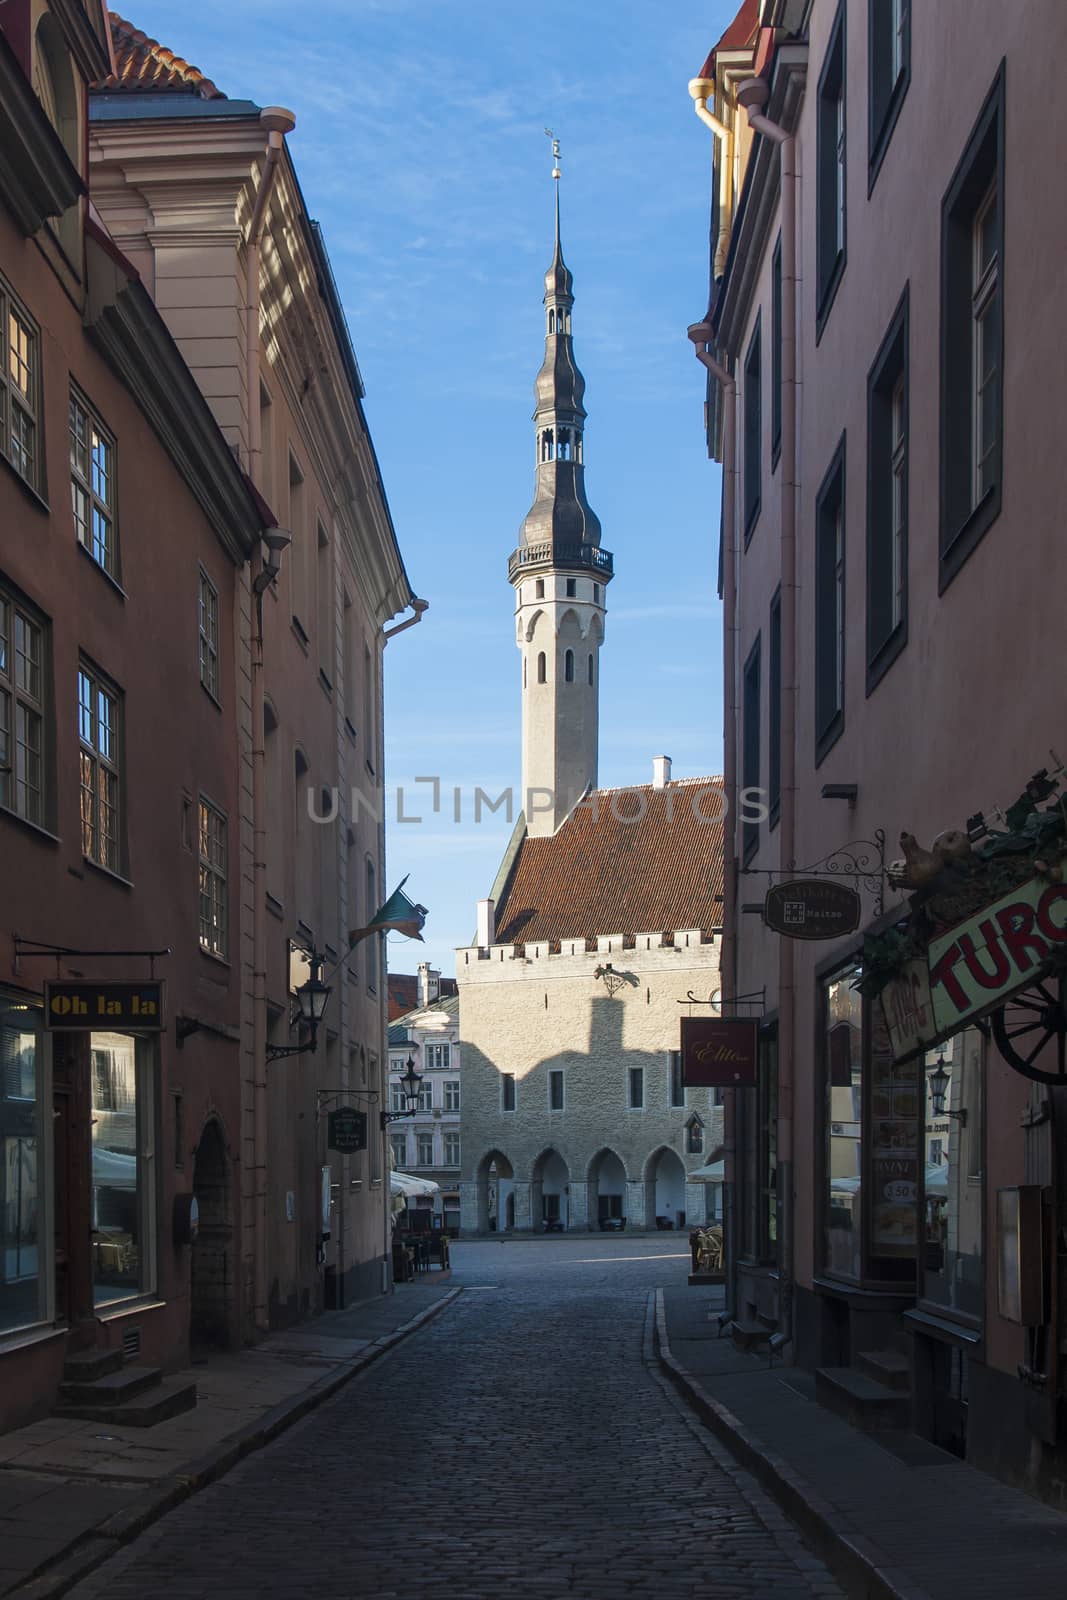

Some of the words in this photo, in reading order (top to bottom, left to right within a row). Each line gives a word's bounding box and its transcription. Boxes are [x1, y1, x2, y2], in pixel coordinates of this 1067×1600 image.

[51, 995, 88, 1015] Oh
[97, 995, 122, 1015] la
[132, 995, 157, 1015] la
